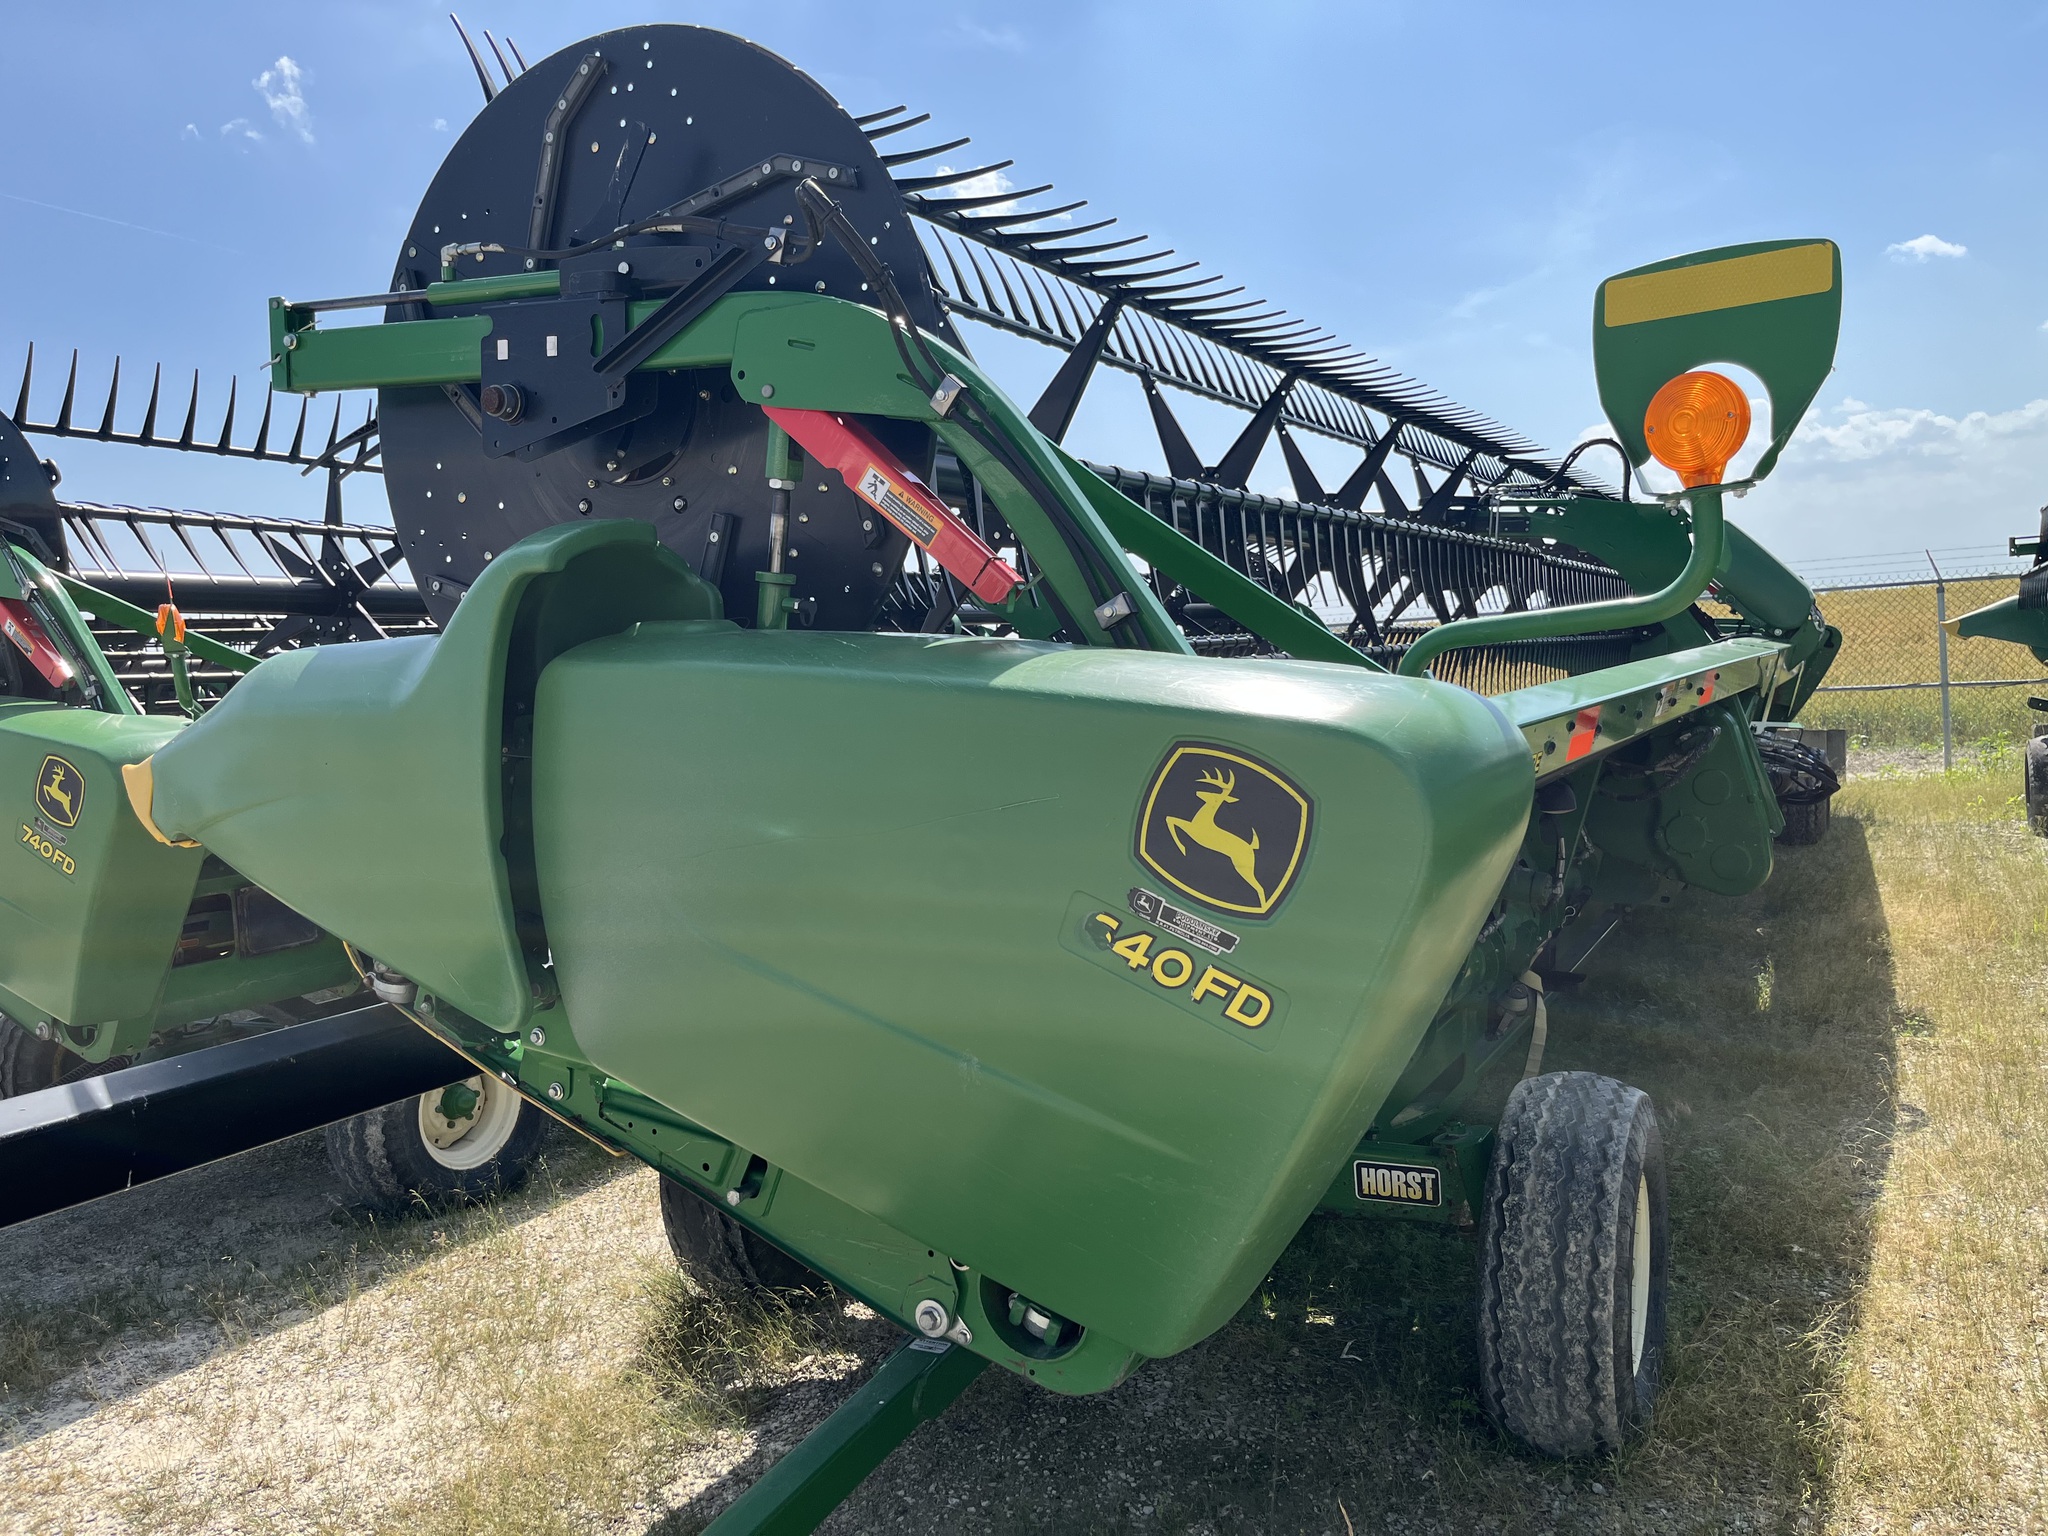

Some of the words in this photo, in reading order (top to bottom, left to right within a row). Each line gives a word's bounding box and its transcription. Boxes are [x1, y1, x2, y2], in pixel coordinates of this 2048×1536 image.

[906, 495, 935, 523] WARNING
[22, 824, 76, 875] 740FD
[1360, 1167, 1435, 1201] HORST
